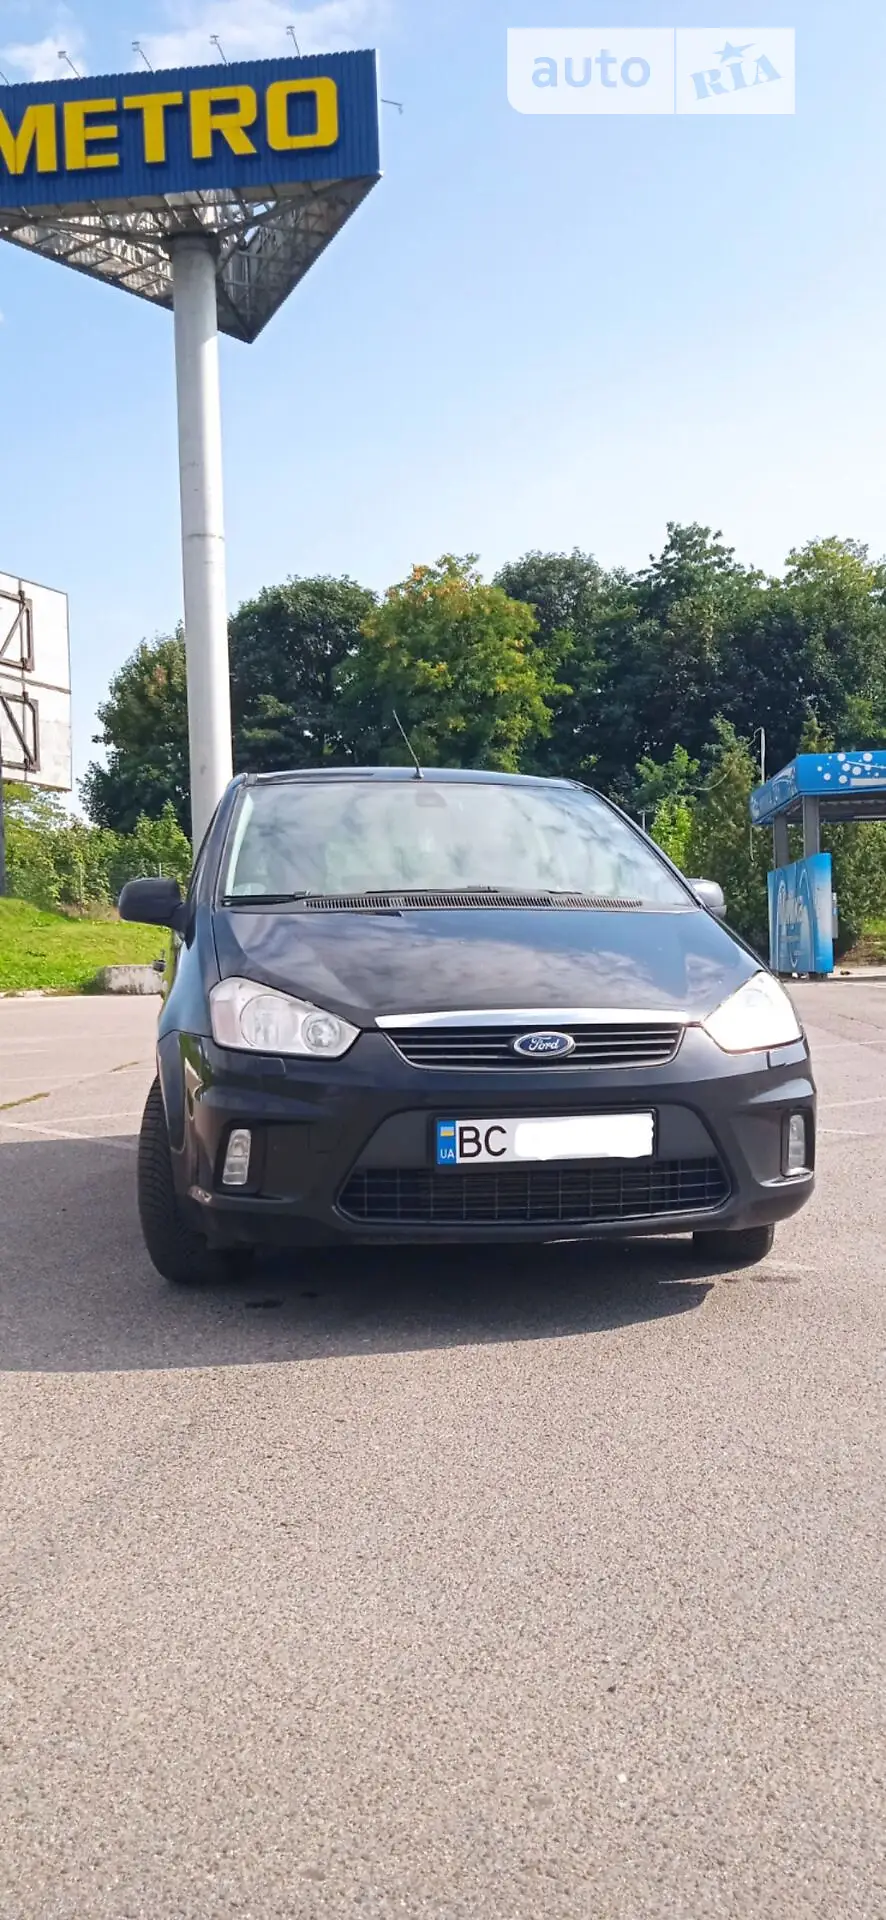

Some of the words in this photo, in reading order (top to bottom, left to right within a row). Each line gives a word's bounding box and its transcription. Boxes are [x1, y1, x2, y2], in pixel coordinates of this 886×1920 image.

[0, 76, 339, 175] METRO
[528, 1036, 561, 1051] Ford
[459, 1125, 507, 1157] BC
[440, 1148, 455, 1159] UA
